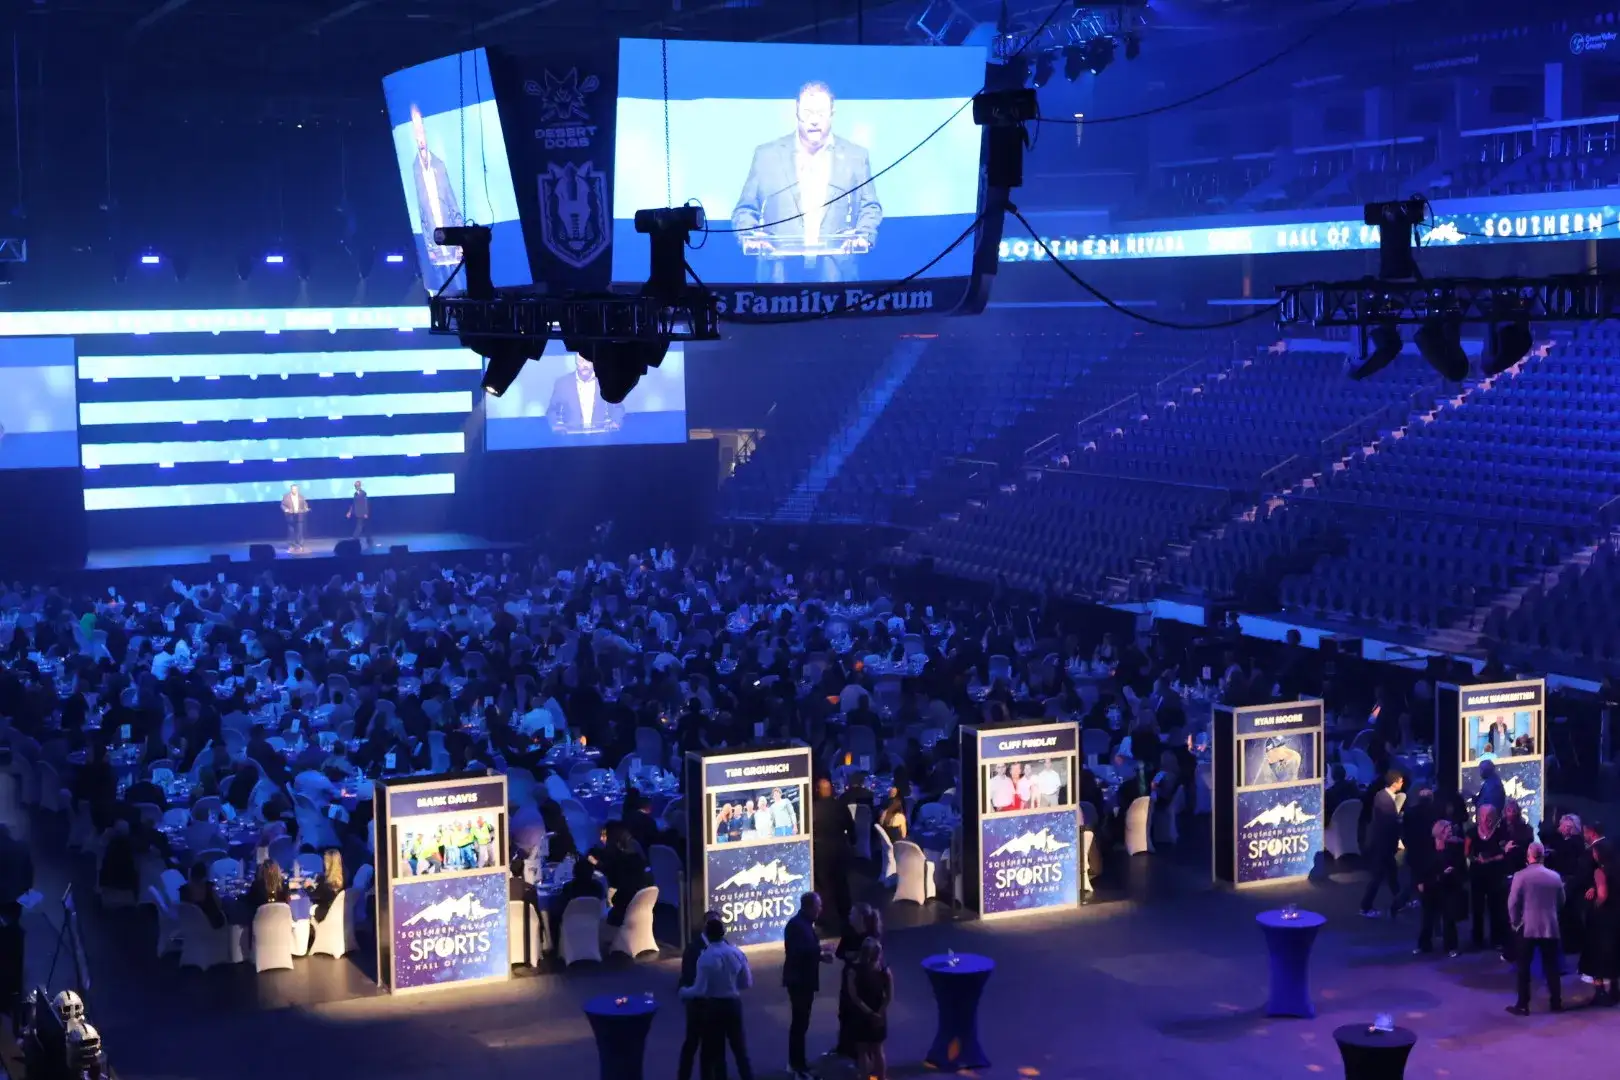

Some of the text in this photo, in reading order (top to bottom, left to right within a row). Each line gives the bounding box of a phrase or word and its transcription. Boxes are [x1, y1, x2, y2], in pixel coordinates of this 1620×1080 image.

[534, 126, 598, 139] DESERT
[545, 137, 590, 149] DOGS
[1484, 212, 1603, 237] SOUTHERN
[1277, 229, 1318, 246] HALL
[1360, 225, 1380, 243] FA
[999, 237, 1119, 258] SOUTHERN
[734, 289, 839, 318] Family
[845, 289, 933, 312] Forum
[1468, 695, 1489, 706] MARK
[1254, 713, 1303, 727] RYAN MOORE
[998, 736, 1057, 750] CLIFF FINDLAY
[725, 767, 743, 778] TIM
[416, 792, 478, 808] MARK DAVIS
[1242, 829, 1283, 840] SOUTHERN
[1248, 833, 1309, 859] SPORTS
[988, 857, 1033, 869] SOUTHERN
[995, 862, 1062, 889] SPORTS
[714, 885, 803, 902] SOUTHERN NEVADA
[999, 884, 1060, 898] HALL OF FAME
[721, 895, 795, 923] SPORTS
[401, 920, 499, 939] SOUTHERN NEVADA
[726, 919, 787, 933] HALL OF FAM
[410, 931, 491, 961] SPORTS
[415, 955, 487, 971] HALL OF FAME
